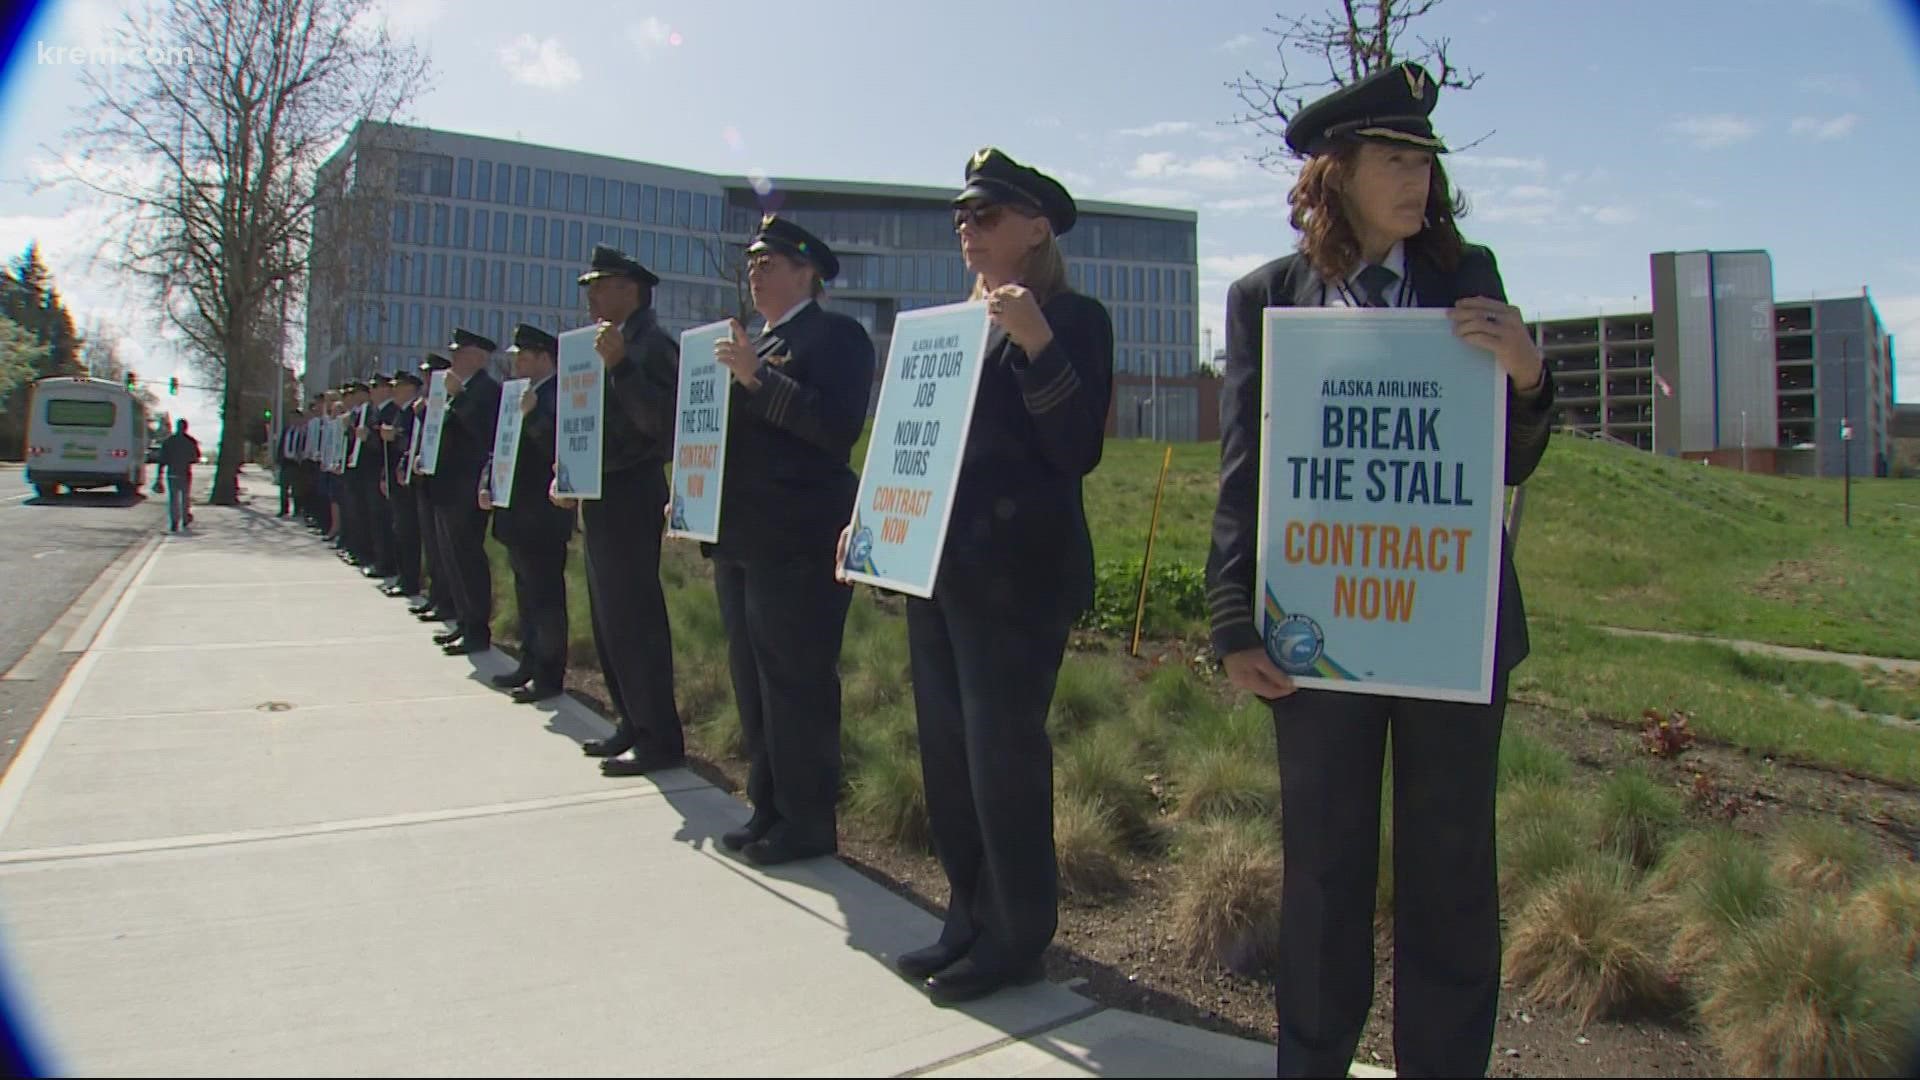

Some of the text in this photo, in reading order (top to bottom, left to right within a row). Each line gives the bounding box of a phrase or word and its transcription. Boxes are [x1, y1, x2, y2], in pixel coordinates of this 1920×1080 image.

[901, 350, 963, 380] WE DO OUR
[689, 379, 715, 405] BREAK
[913, 382, 937, 407] JOB
[1321, 380, 1443, 399] ALASKA AIRLINES:
[682, 408, 720, 434] THE STALL
[893, 420, 940, 447] NOW DO
[1322, 405, 1441, 452] BREAK
[892, 449, 930, 476] YOURS
[1287, 457, 1473, 506] THE STALL
[873, 487, 932, 518] CONTRACT
[881, 517, 910, 545] NOW
[1283, 520, 1473, 574] CONTRACT
[1333, 575, 1417, 624] NOW
